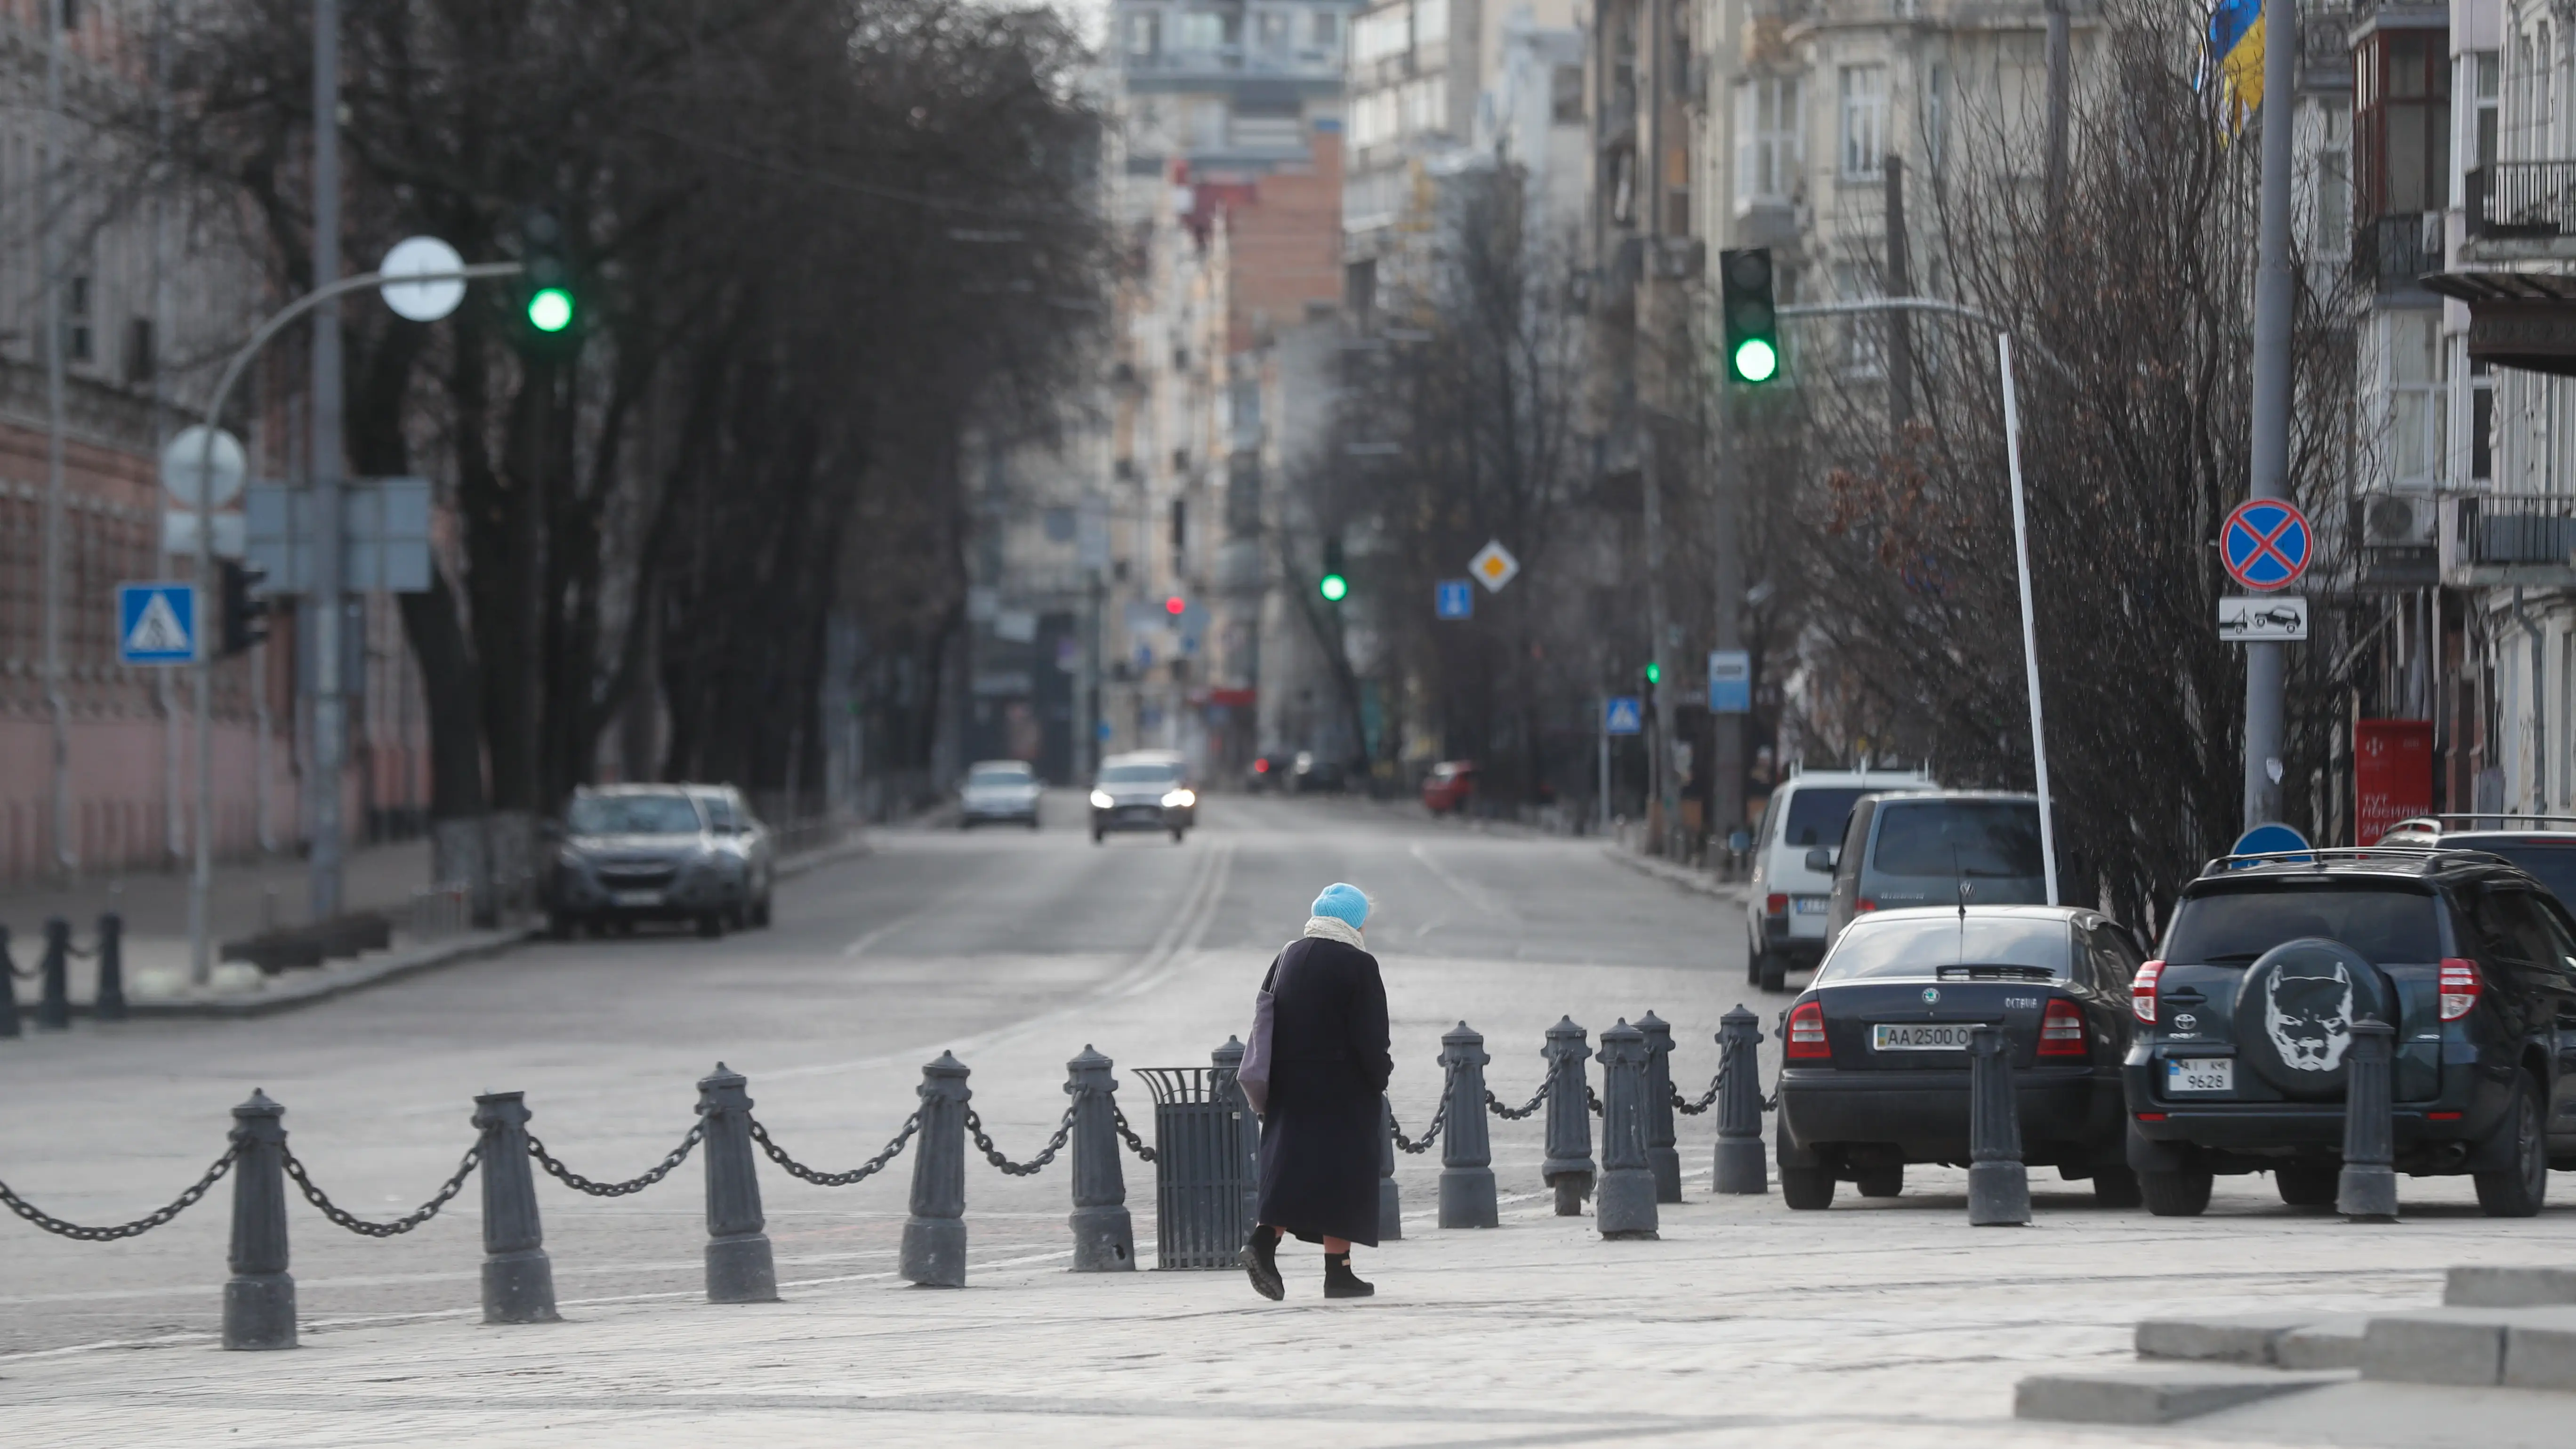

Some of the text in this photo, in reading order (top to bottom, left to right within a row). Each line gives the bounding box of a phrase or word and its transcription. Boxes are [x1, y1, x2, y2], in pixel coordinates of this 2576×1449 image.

[2362, 793, 2388, 806] ТУТ
[1888, 1029, 1910, 1045] AA
[1915, 1029, 1953, 1045] 2500
[2188, 1074, 2223, 1089] 9628
